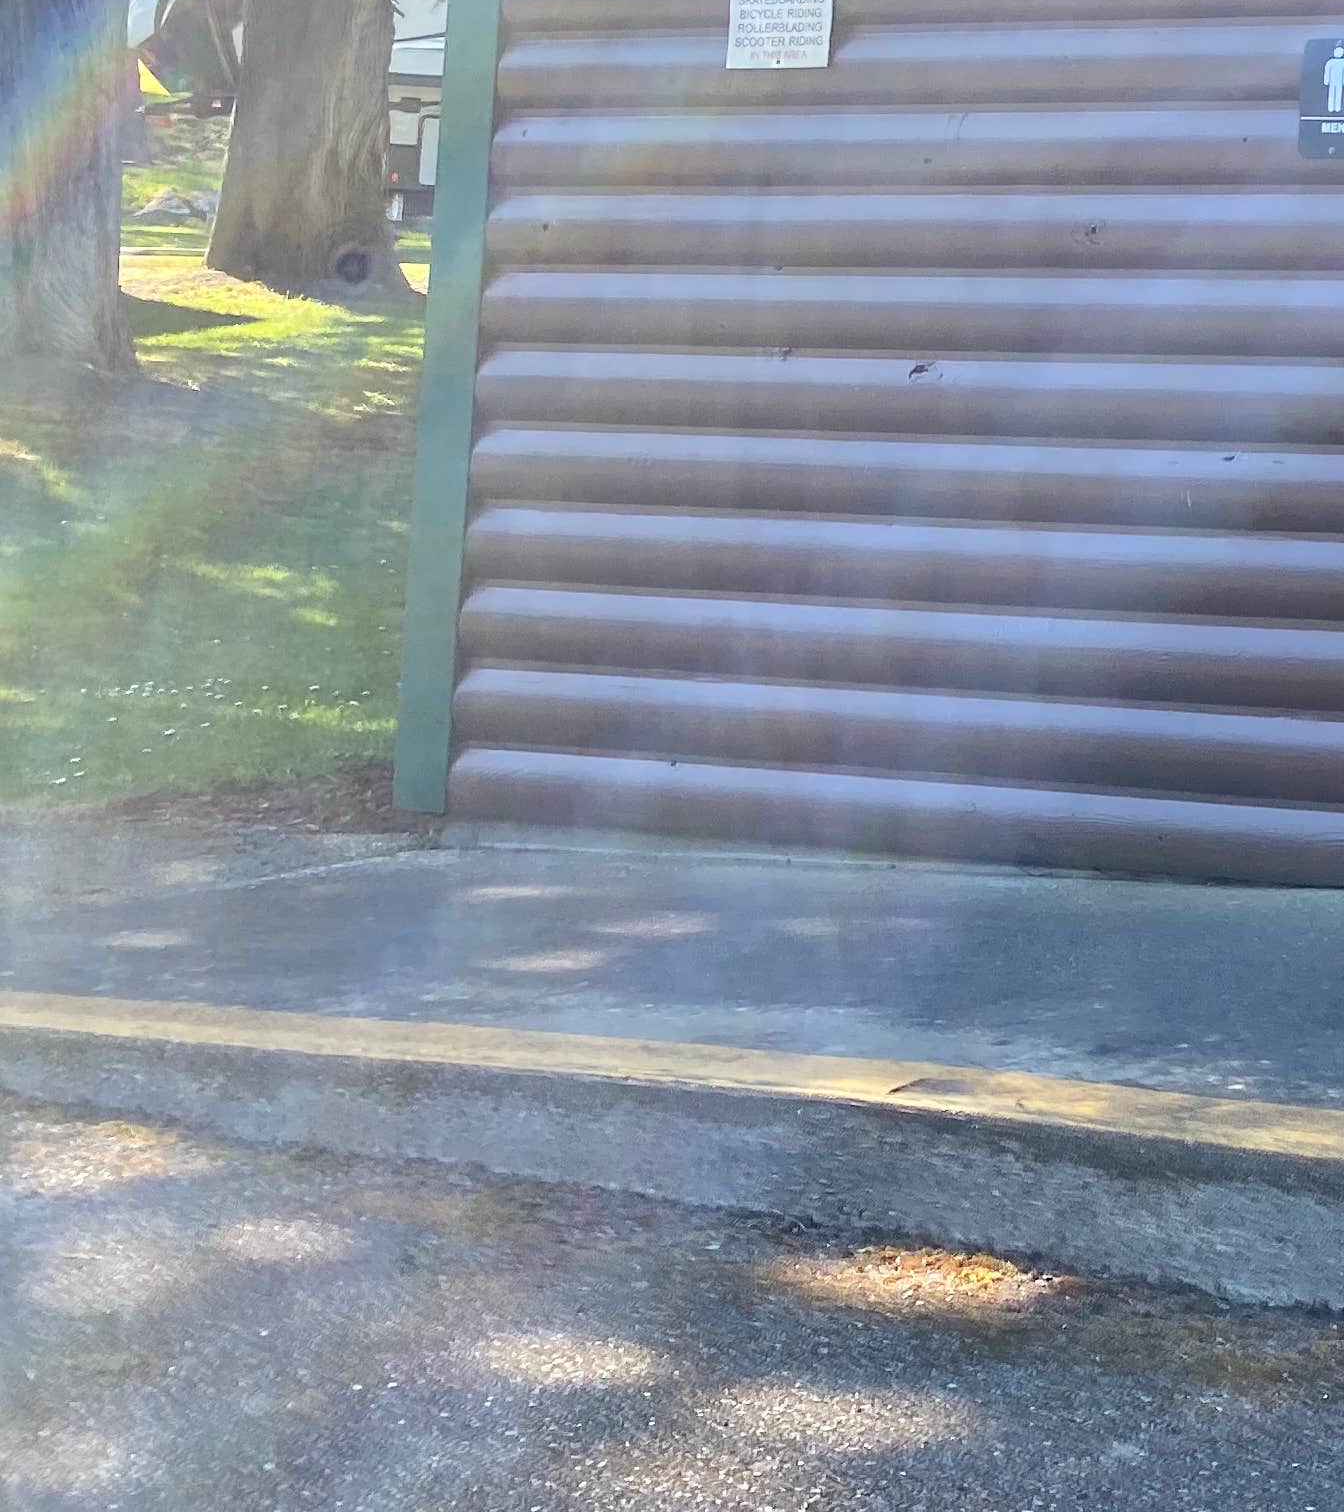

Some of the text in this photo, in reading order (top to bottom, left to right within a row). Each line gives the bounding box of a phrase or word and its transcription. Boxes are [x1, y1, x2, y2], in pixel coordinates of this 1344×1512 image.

[739, 7, 822, 20] BICYCLE RIDING
[737, 21, 823, 34] ROLLERBLADING
[734, 35, 823, 48] SCOOTER RIDING
[783, 49, 808, 59] AREA
